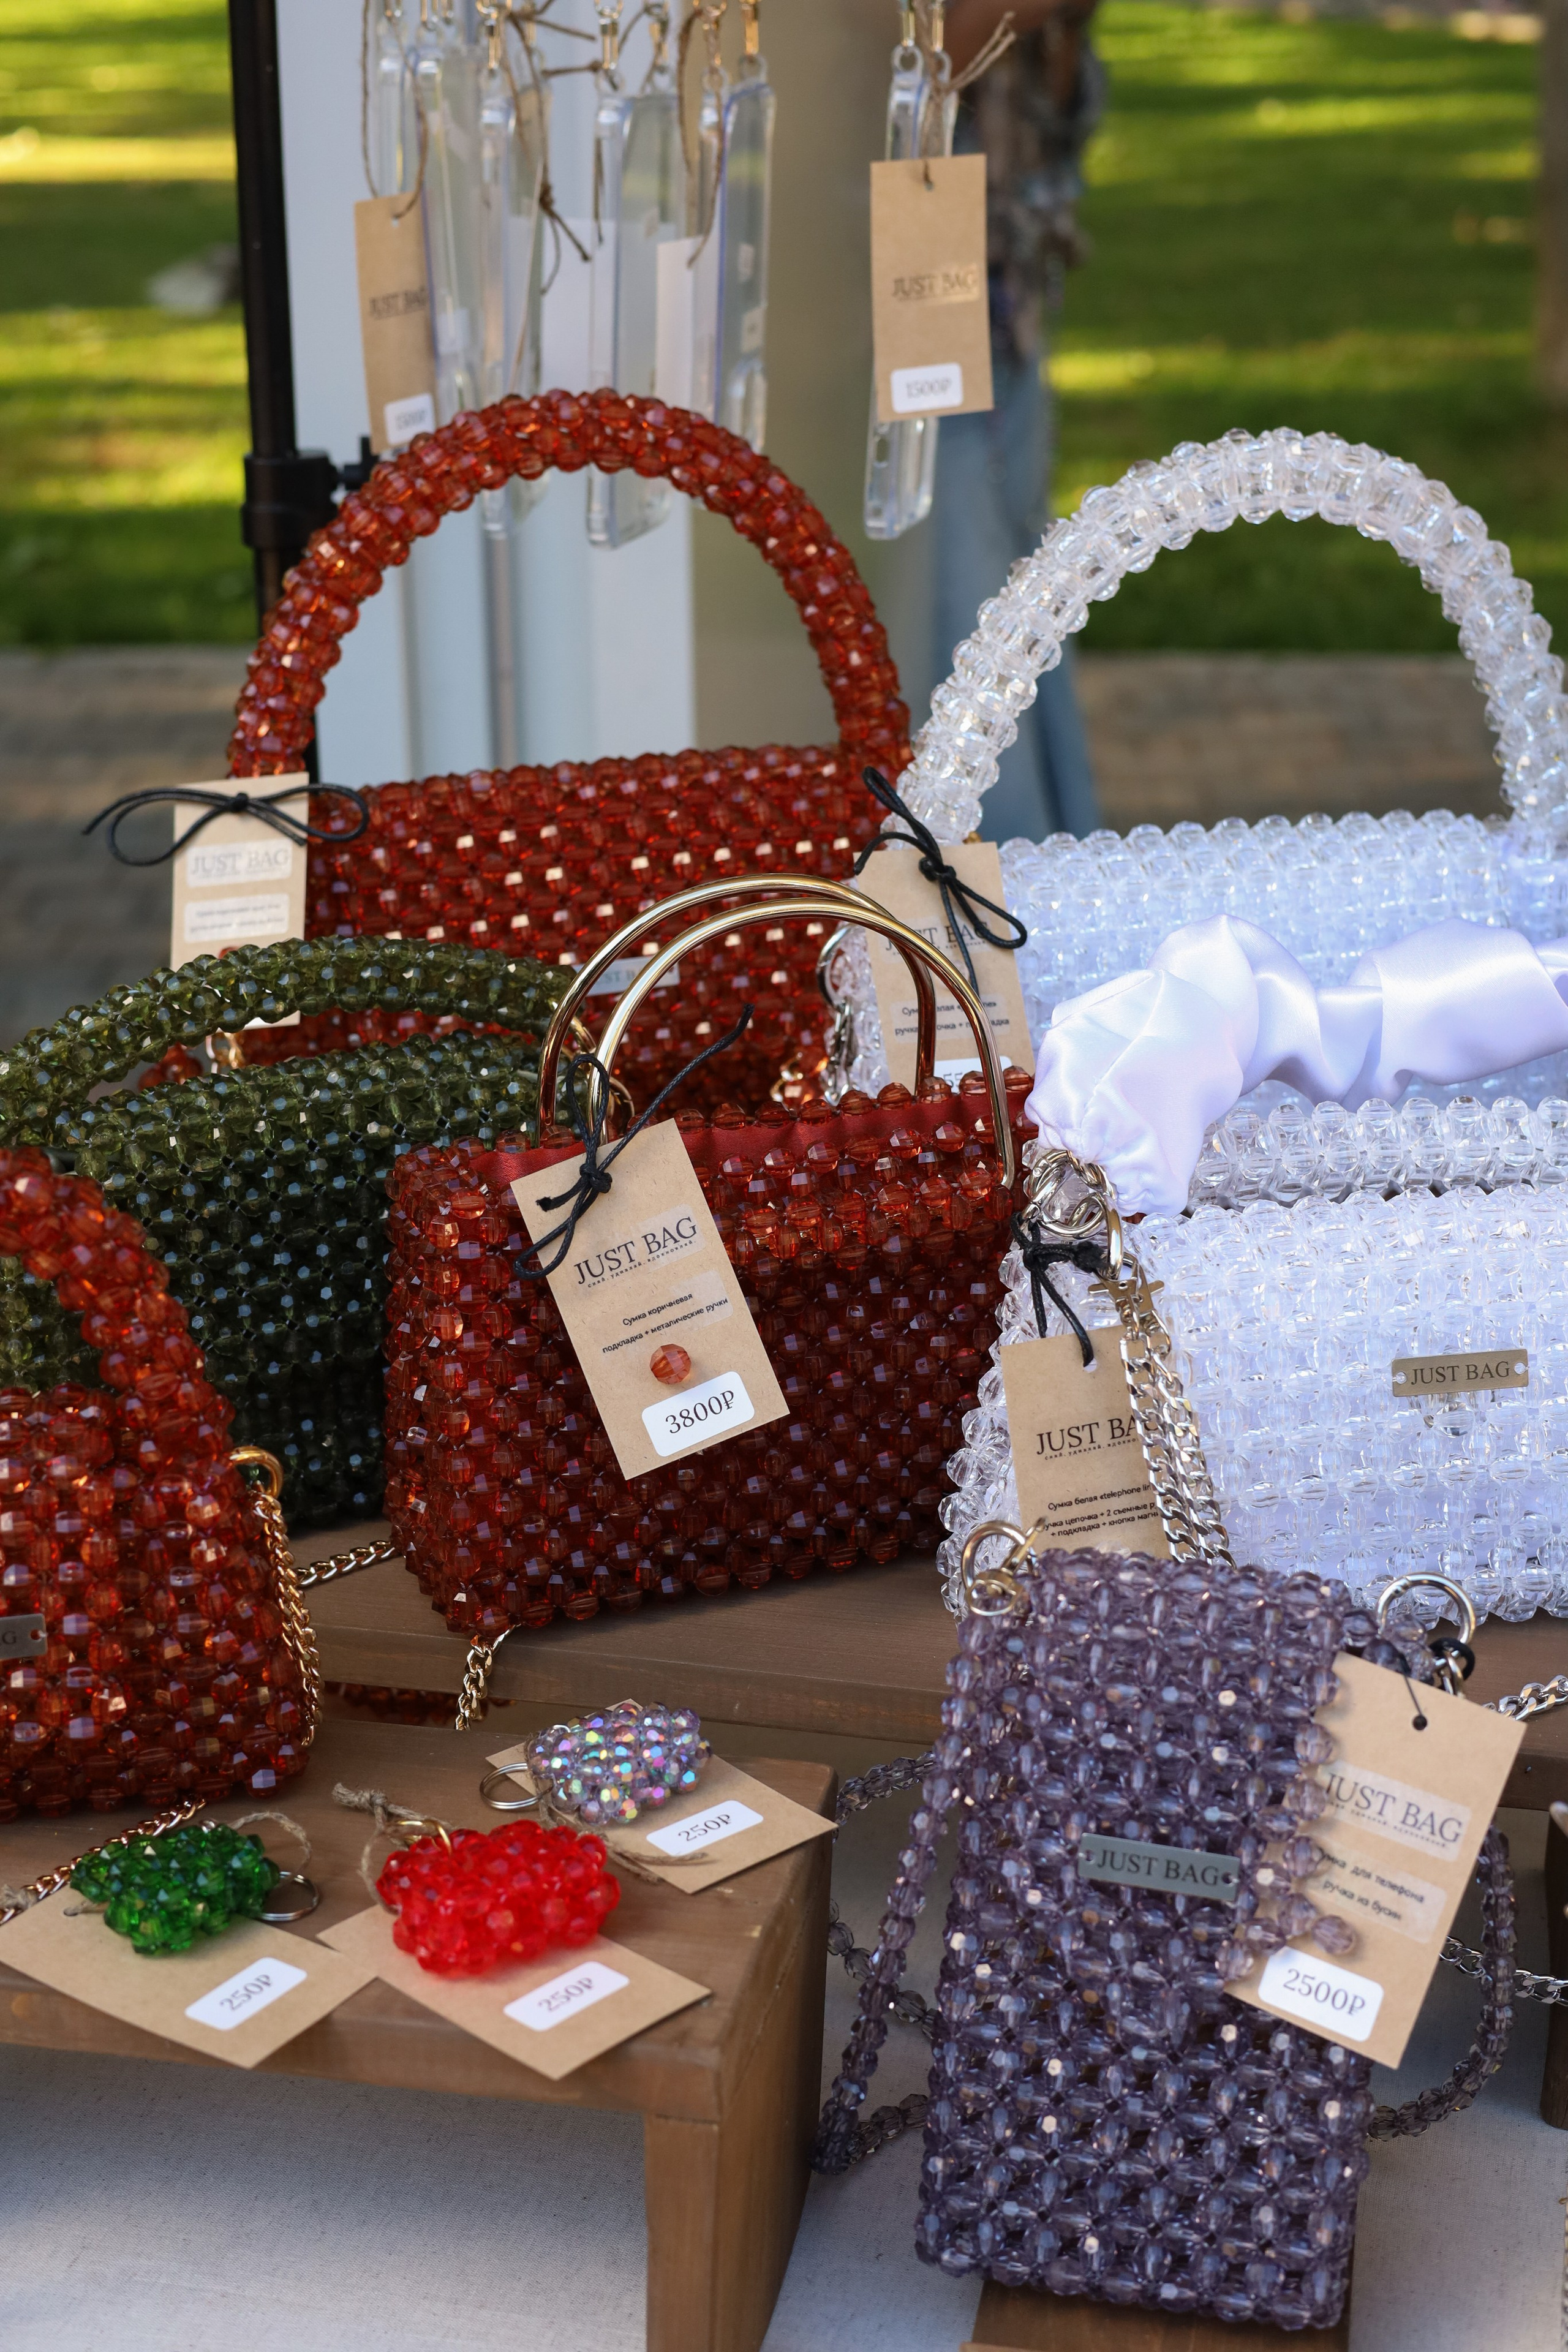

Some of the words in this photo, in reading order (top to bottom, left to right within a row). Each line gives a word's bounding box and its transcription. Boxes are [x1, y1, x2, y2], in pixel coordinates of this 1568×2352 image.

[191, 851, 242, 875] JUST
[247, 848, 288, 869] BAG
[574, 1240, 635, 1285] JUST
[641, 1216, 697, 1255] BAG
[602, 1332, 644, 1354] подкладка
[650, 1307, 705, 1334] металические
[705, 1297, 728, 1313] ручки
[622, 1312, 647, 1326] Сумка
[647, 1292, 693, 1316] коричневая
[1411, 1365, 1459, 1385] JUST
[1465, 1360, 1510, 1381] BAG
[1036, 1422, 1100, 1455] JUST
[1044, 1520, 1064, 1531] учка
[1065, 1513, 1098, 1526] цепочка
[1113, 1504, 1148, 1515] съемные
[1048, 1501, 1072, 1511] Сумка
[1074, 1496, 1098, 1506] белая
[1057, 1523, 1101, 1537] подкладка
[1108, 1516, 1136, 1526] кнопка
[1325, 1772, 1396, 1817] JUST
[1400, 1801, 1463, 1843] BAG
[1096, 1849, 1158, 1875] JUST
[1164, 1859, 1219, 1887] BAG
[1350, 1866, 1372, 1880] для
[1375, 1875, 1425, 1904] телефона
